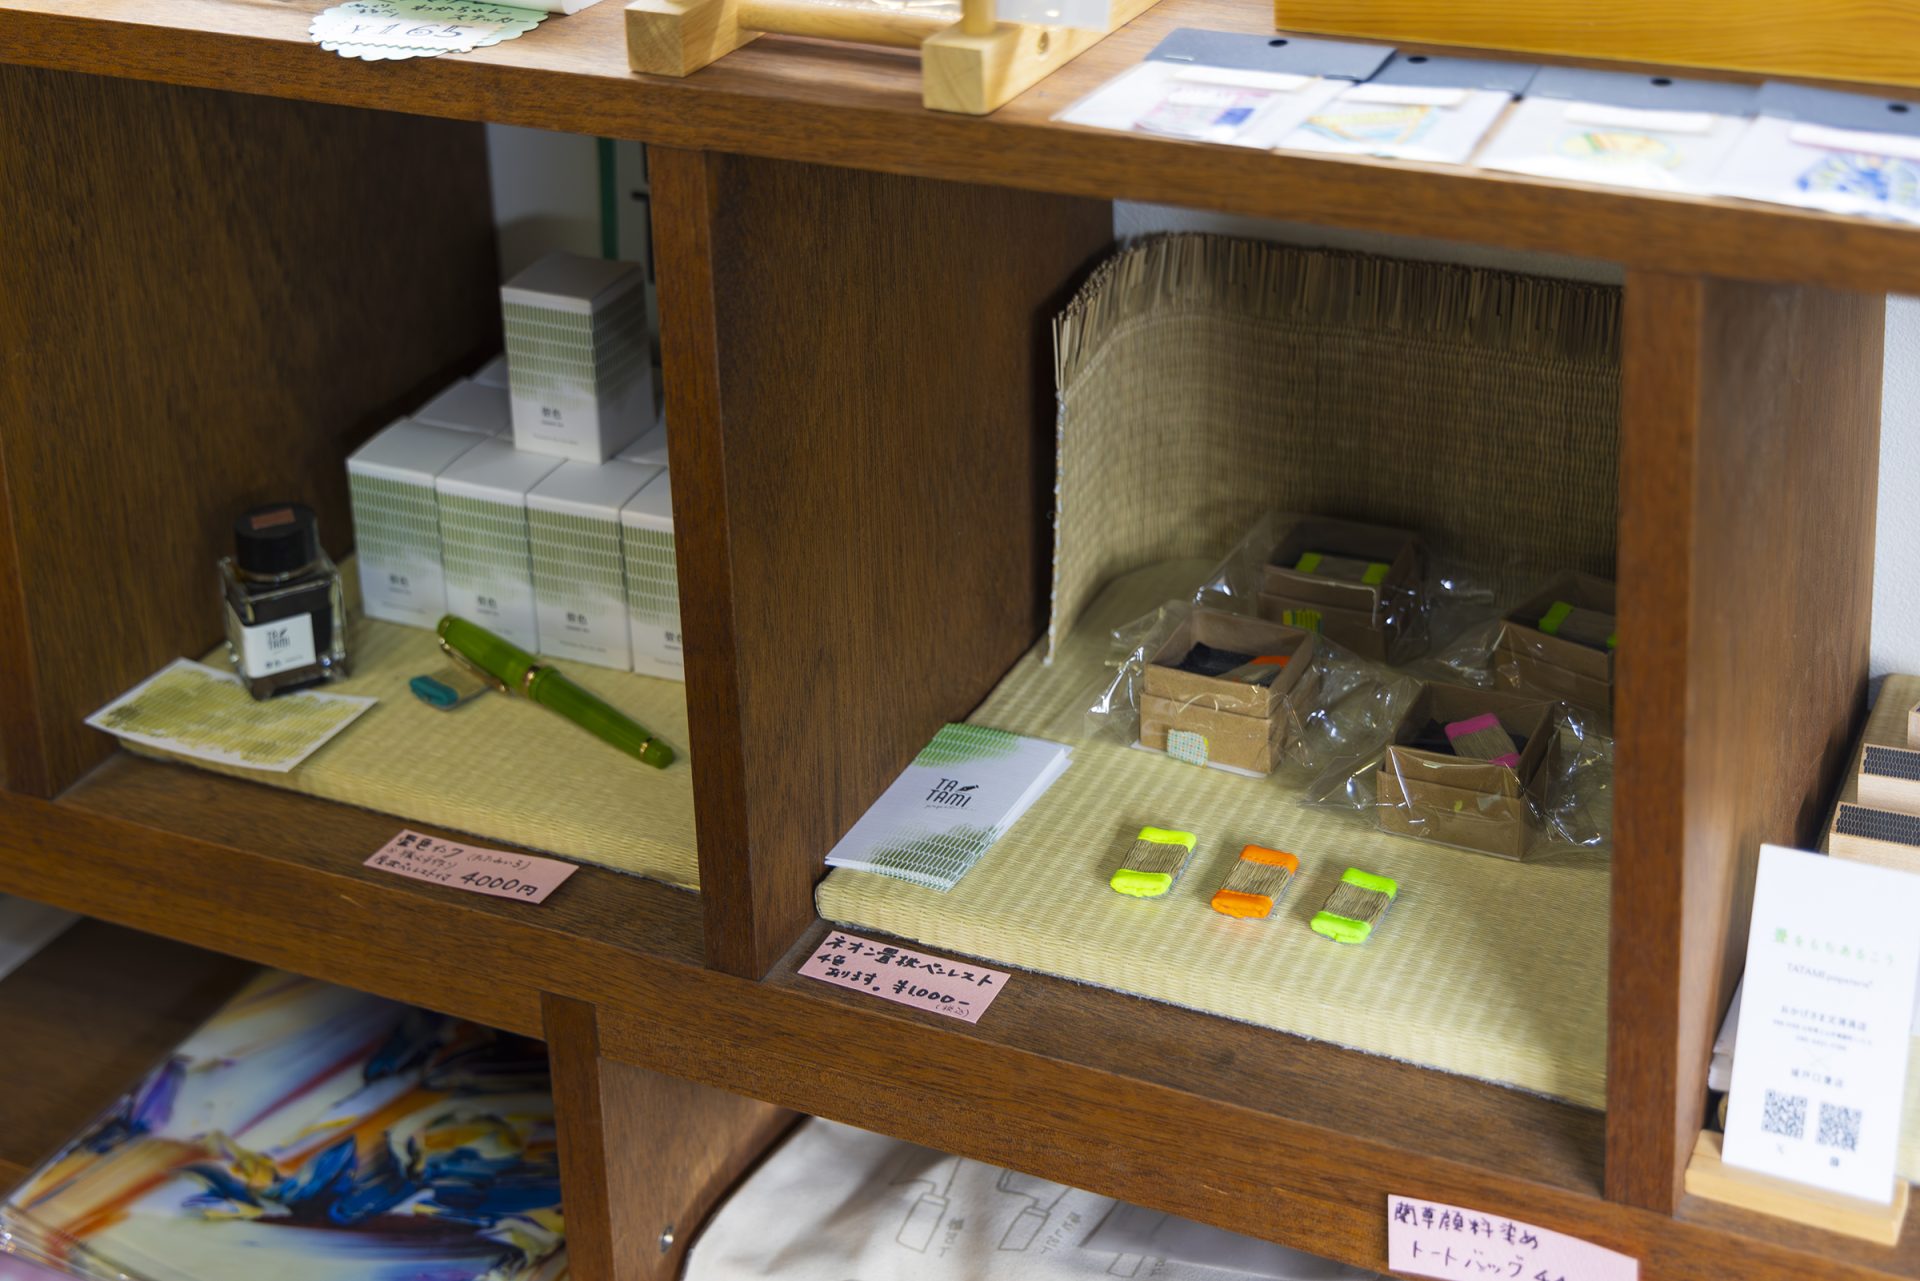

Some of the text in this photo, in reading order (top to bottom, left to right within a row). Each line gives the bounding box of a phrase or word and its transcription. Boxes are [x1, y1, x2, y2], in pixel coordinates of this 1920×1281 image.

[930, 777, 959, 792] TA
[925, 789, 972, 808] TAMI
[460, 871, 538, 896] 4000円
[816, 953, 847, 966] 4色
[825, 967, 881, 992] あります。
[1785, 961, 1826, 979] TATAMI
[1412, 1239, 1525, 1278] トートバッグ
